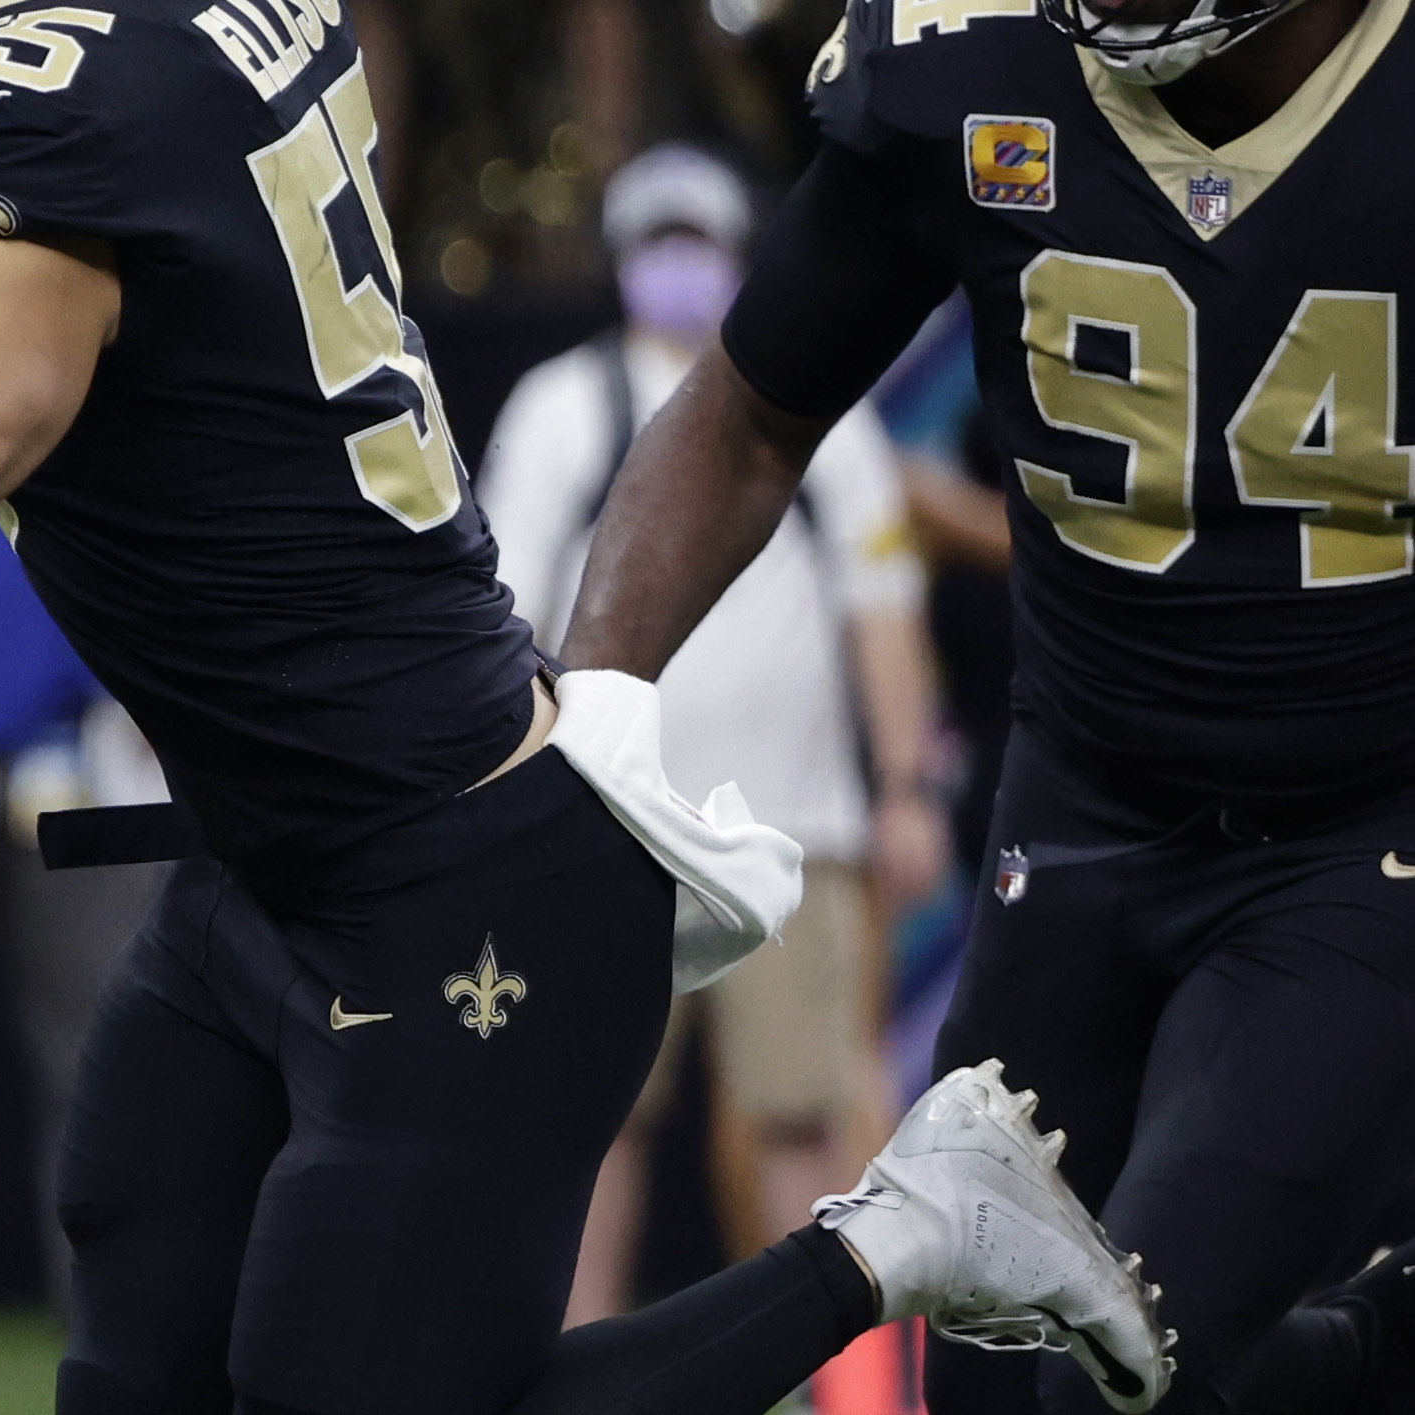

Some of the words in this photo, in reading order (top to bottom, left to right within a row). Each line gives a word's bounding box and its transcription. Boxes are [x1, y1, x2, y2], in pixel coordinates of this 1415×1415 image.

[972, 124, 1049, 185] C
[1194, 195, 1226, 220] NFL
[1014, 247, 1415, 589] 94
